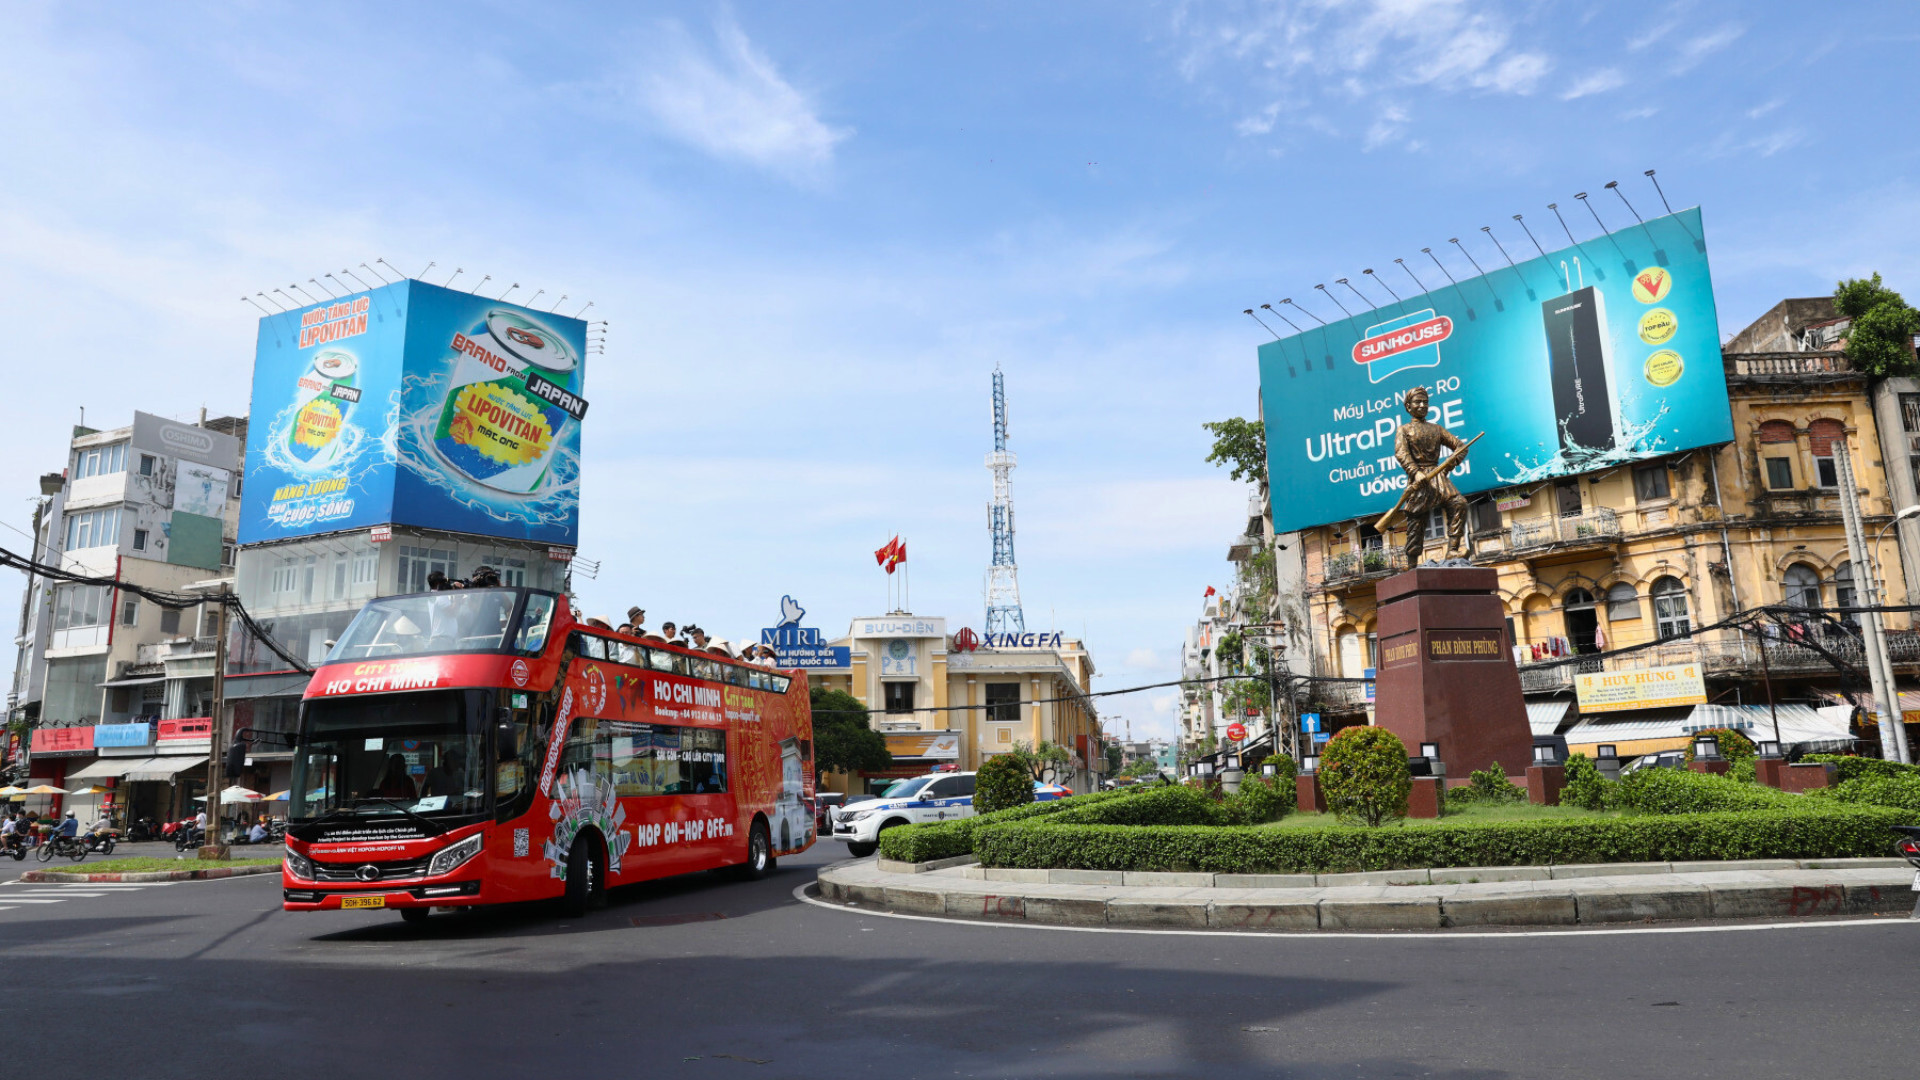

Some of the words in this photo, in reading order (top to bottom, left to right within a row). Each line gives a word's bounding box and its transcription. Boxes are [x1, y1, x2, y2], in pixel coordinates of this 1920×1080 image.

[299, 313, 368, 349] LIPOVITAN
[1361, 322, 1443, 357] SUNHOUSE
[452, 333, 507, 373] BRAND
[506, 366, 527, 381] FROM
[529, 379, 583, 416] JAPAN
[332, 386, 359, 402] JAPAN
[1333, 404, 1364, 421] Máy
[1367, 397, 1392, 414] Lọc
[1436, 376, 1460, 394] RO
[303, 410, 338, 429] LIPOVITAN
[466, 393, 543, 444] LIPOVITAN
[166, 430, 207, 449] OSHIMA
[1329, 461, 1375, 483] Chuẩn
[1360, 474, 1408, 496] UỐNG
[268, 503, 287, 515] CHO
[764, 629, 819, 646] MIRI
[982, 632, 1062, 648] XINGFA
[1431, 641, 1452, 654] PHAN
[1453, 637, 1472, 654] ĐÌNH
[1473, 637, 1498, 654] PHÙNG
[818, 646, 834, 657] ĐẾN
[354, 663, 385, 676] CITY
[780, 657, 798, 667] HIỆU
[800, 656, 821, 665] QUỐC
[325, 680, 351, 695] HO
[355, 676, 387, 692] CHI
[390, 673, 439, 690] MINH
[1602, 675, 1631, 686] HUY
[1636, 670, 1676, 683] HÙNG
[653, 679, 672, 702] HO
[673, 683, 693, 704] CHI
[694, 686, 721, 708] MINH
[724, 686, 739, 707] CITY
[655, 706, 679, 719] Booking:
[703, 752, 713, 762] CITY
[638, 823, 661, 847] HOP
